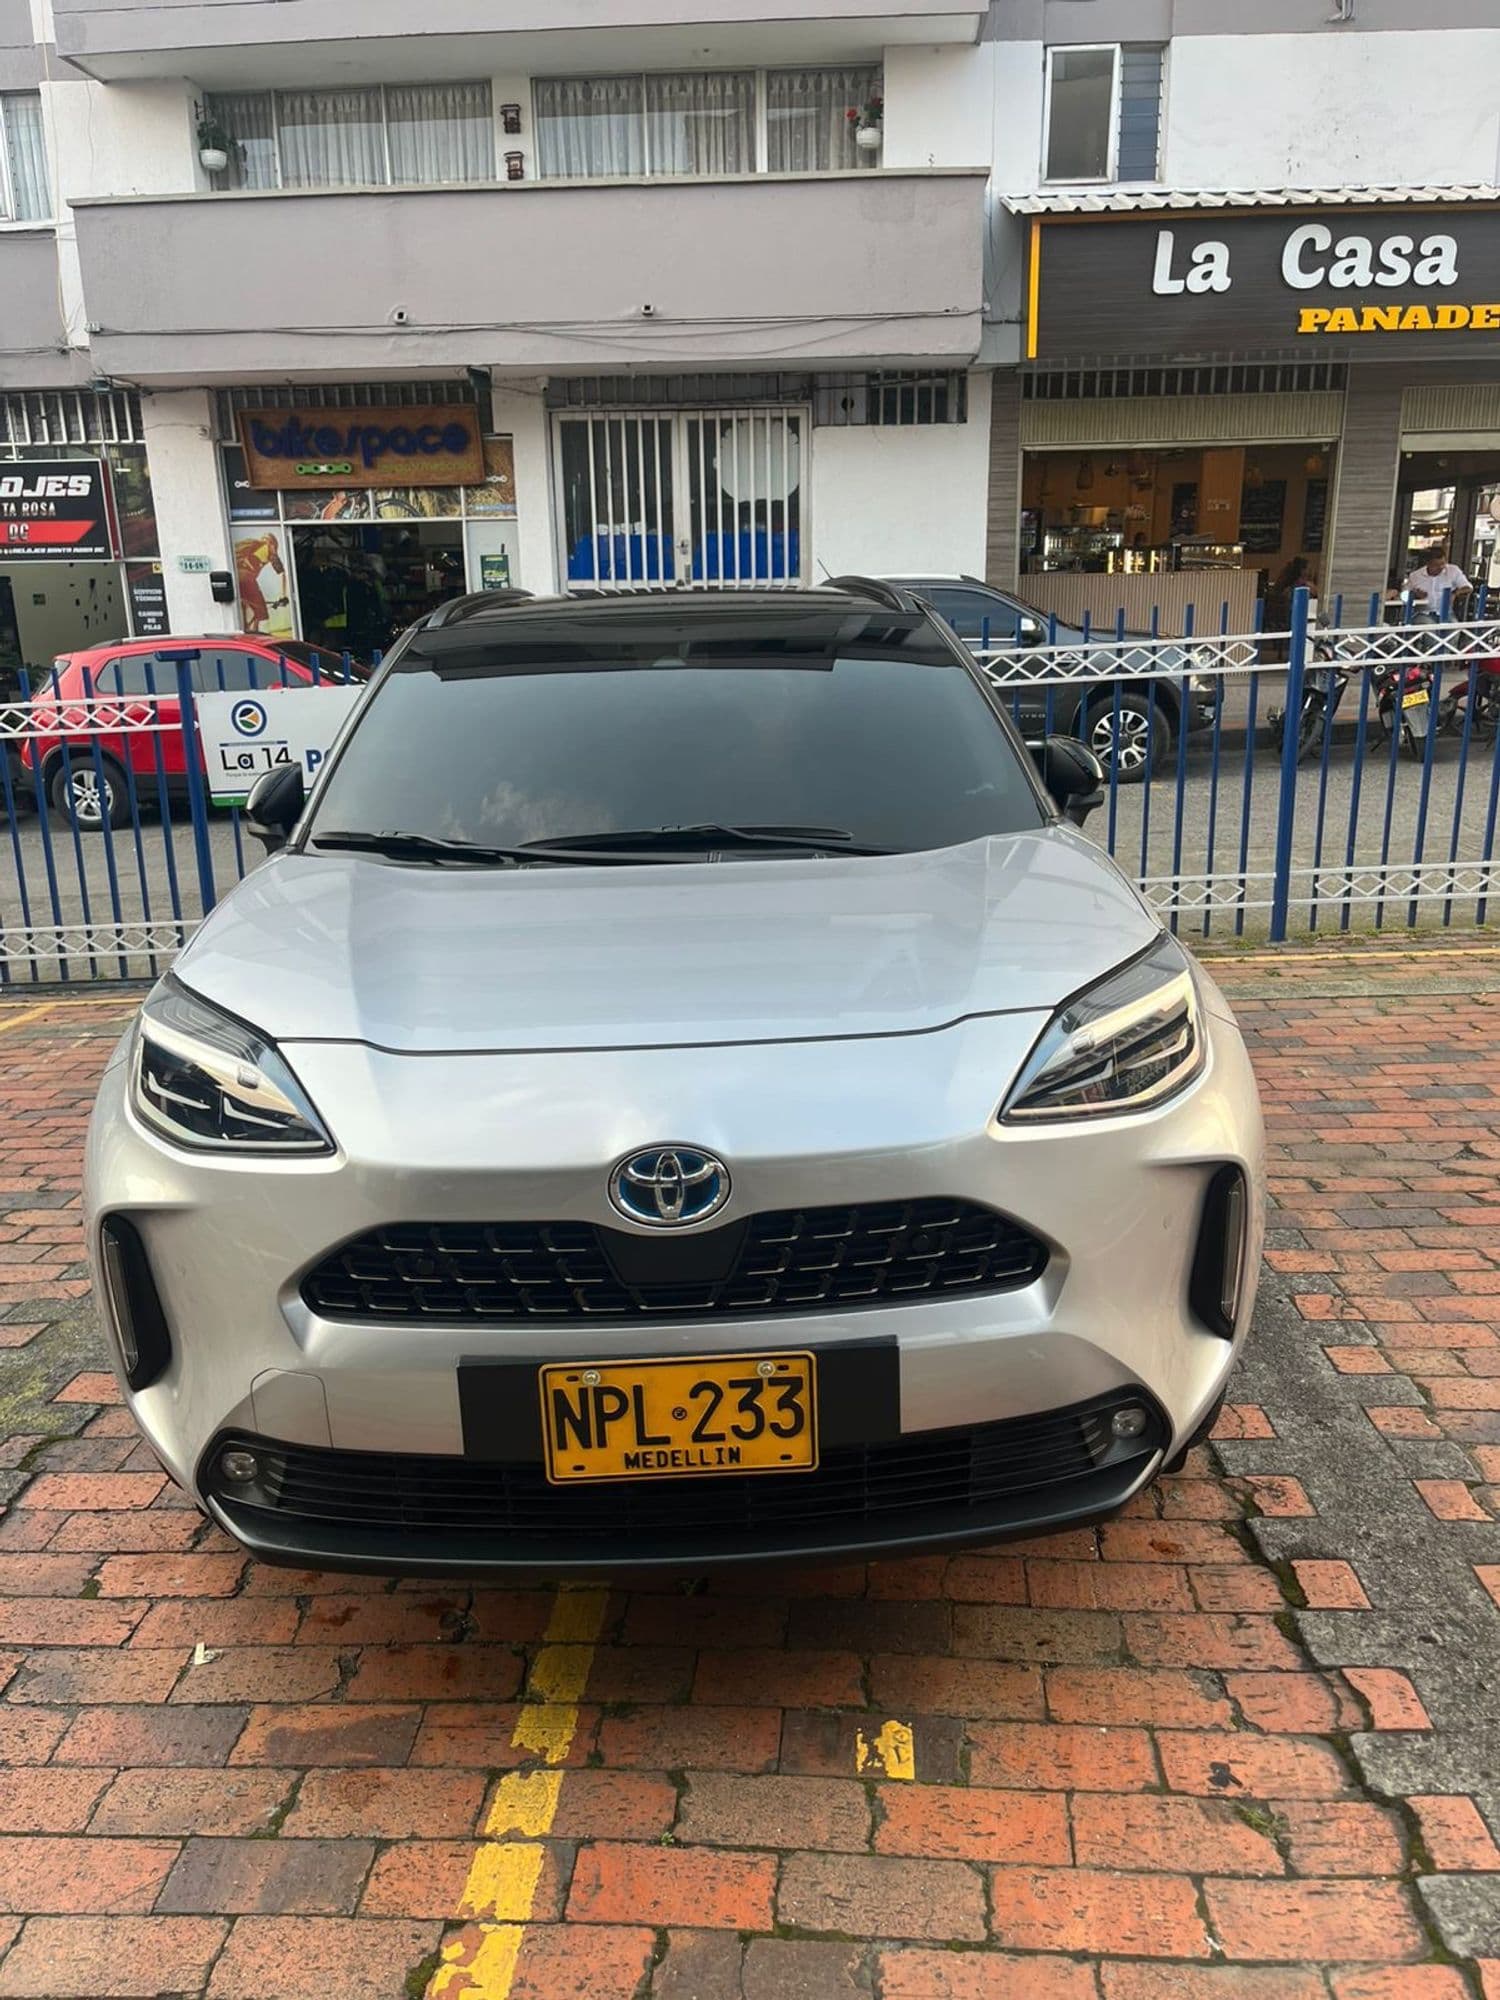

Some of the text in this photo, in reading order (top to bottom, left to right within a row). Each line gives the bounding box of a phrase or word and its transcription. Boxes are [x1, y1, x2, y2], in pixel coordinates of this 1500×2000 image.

[1153, 224, 1459, 294] La Casa
[1297, 304, 1500, 333] PANADE
[22, 502, 57, 517] ROSA
[220, 749, 255, 771] La
[262, 747, 293, 769] 14
[553, 1376, 805, 1450] NPL 233
[624, 1447, 742, 1470] MEDELLIN
